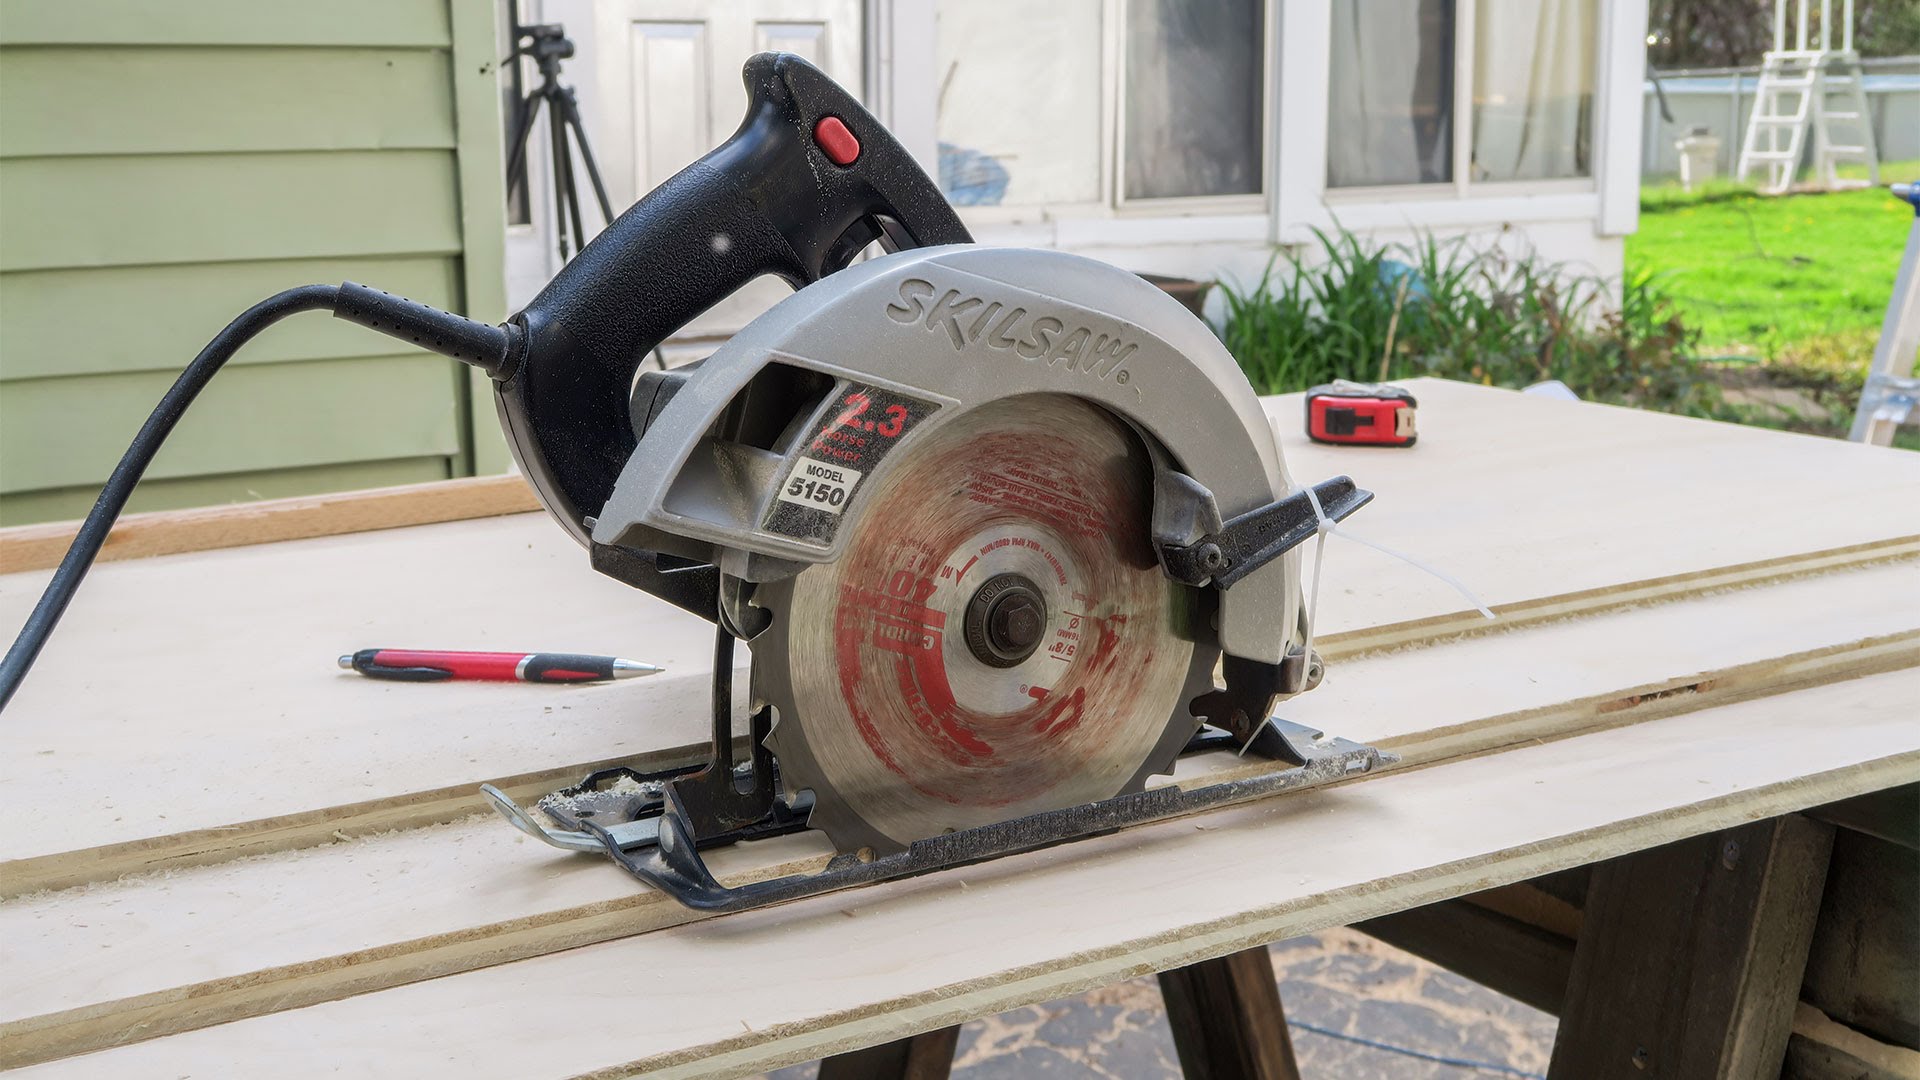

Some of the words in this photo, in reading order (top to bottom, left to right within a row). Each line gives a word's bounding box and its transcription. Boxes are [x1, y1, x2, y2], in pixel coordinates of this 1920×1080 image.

[886, 278, 1139, 381] SKILSAW
[843, 392, 908, 438] 2.3
[806, 463, 846, 484] MODEL
[787, 476, 846, 507] 5150
[1011, 537, 1026, 547] RPM
[1027, 539, 1041, 552] MAX
[979, 588, 995, 604] DO
